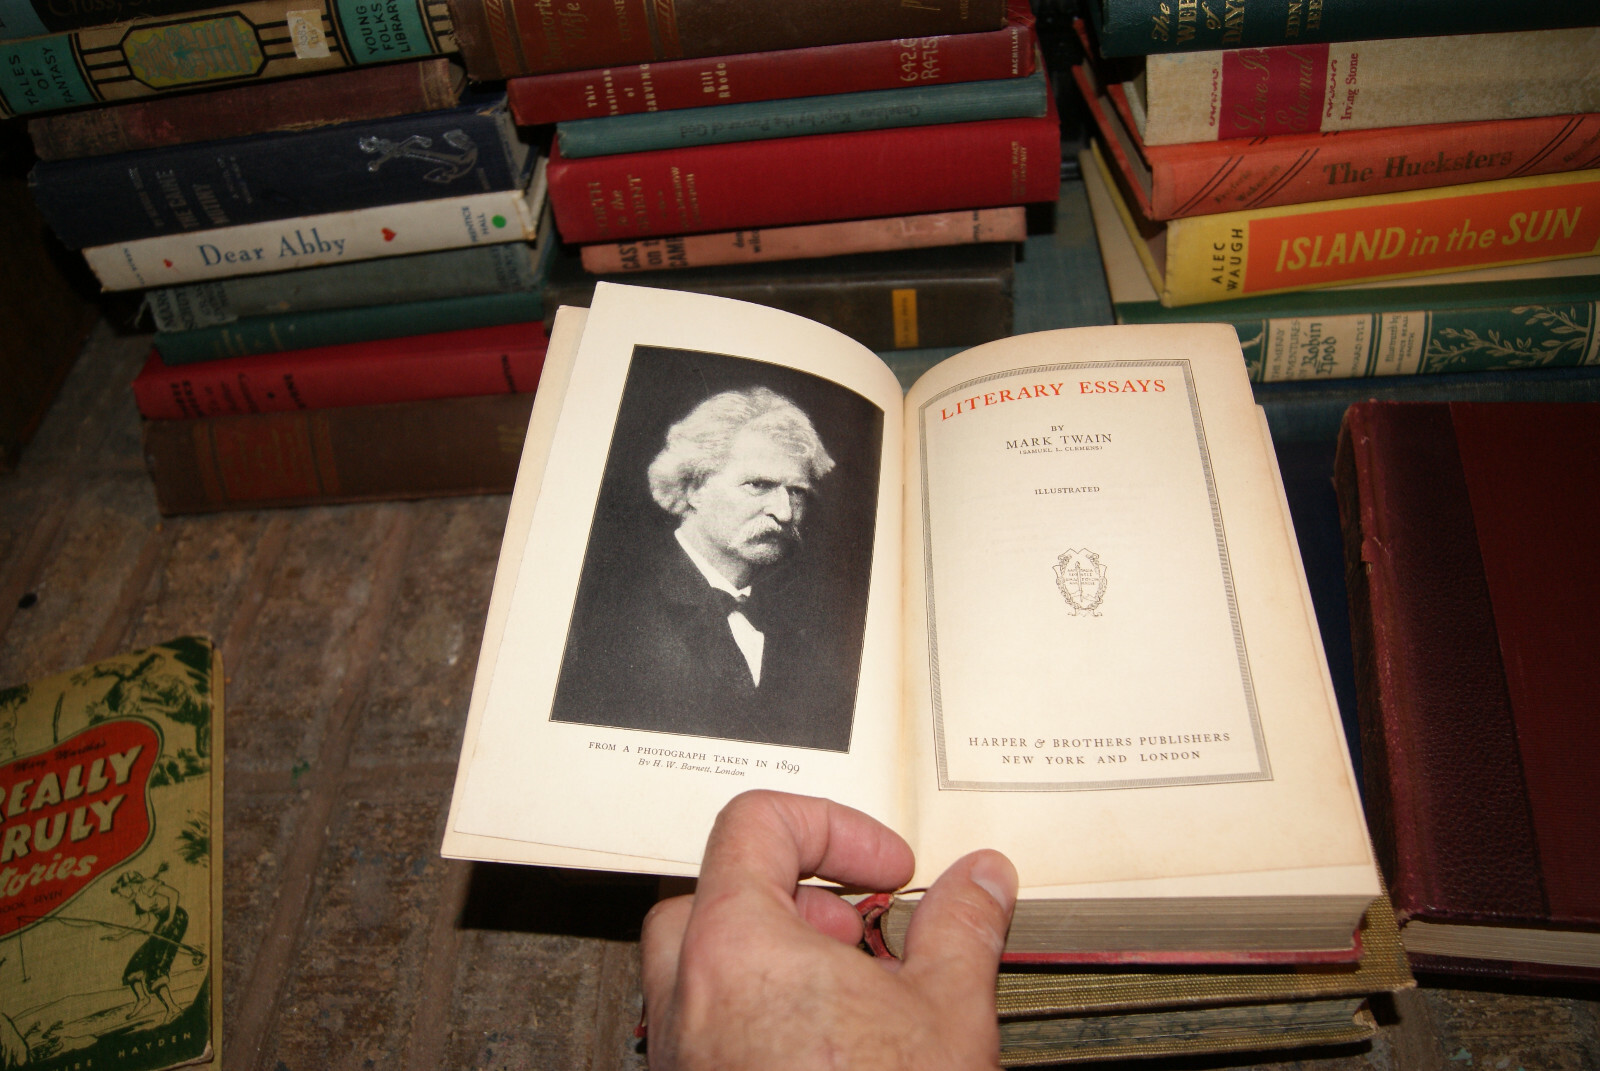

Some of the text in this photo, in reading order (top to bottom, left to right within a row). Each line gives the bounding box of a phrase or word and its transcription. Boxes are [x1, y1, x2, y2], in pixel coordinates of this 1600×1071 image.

[356, 5, 378, 55] YOUNG
[371, 3, 395, 51] FOLKS
[533, 0, 564, 66] Immort
[1152, 3, 1171, 42] The
[1201, 1, 1221, 30] of
[1222, 0, 1244, 45] DAY
[1286, 0, 1302, 39] EDN
[921, 37, 939, 80] R475
[1012, 27, 1020, 75] MACMILLAN
[9, 54, 40, 106] TALES
[30, 68, 49, 90] OF
[42, 46, 74, 104] FANTASY
[623, 87, 635, 98] of
[700, 71, 716, 93] Bill
[716, 62, 731, 98] Rhode
[1276, 50, 1314, 132] Eternal
[1341, 52, 1360, 121] Irving Stone
[585, 84, 597, 108] This
[1233, 82, 1270, 131] Love
[680, 125, 707, 138] God
[1322, 150, 1514, 187] The Hucksters
[197, 226, 346, 267] Dear Abby
[647, 250, 662, 266] on
[1226, 228, 1243, 292] WAUGH
[1275, 206, 1583, 273] ISLAND in the SUN
[1210, 241, 1226, 284] ALEC
[1302, 322, 1323, 367] Robin
[1315, 335, 1338, 376] Hood
[940, 379, 1166, 422] LITERARY ESSAYS
[1006, 433, 1112, 450] MARK TWAIN
[1051, 424, 1064, 432] BY
[1034, 486, 1100, 495] ILLUSTRATED
[588, 741, 801, 775] FROM A PHOTOGRAPH TAKEN IN 1899
[968, 732, 1231, 749] HARPER & BROTHERS PUBLISHERS
[1002, 750, 1201, 765] NEW YORK AND LONDON
[0, 744, 144, 823] EALLY
[638, 758, 651, 767] By
[652, 759, 664, 768] H.
[666, 761, 678, 770] W.
[714, 765, 745, 777] London
[0, 794, 127, 864] RULY
[0, 853, 98, 898] tories
[118, 1032, 191, 1058] HAYDEN
